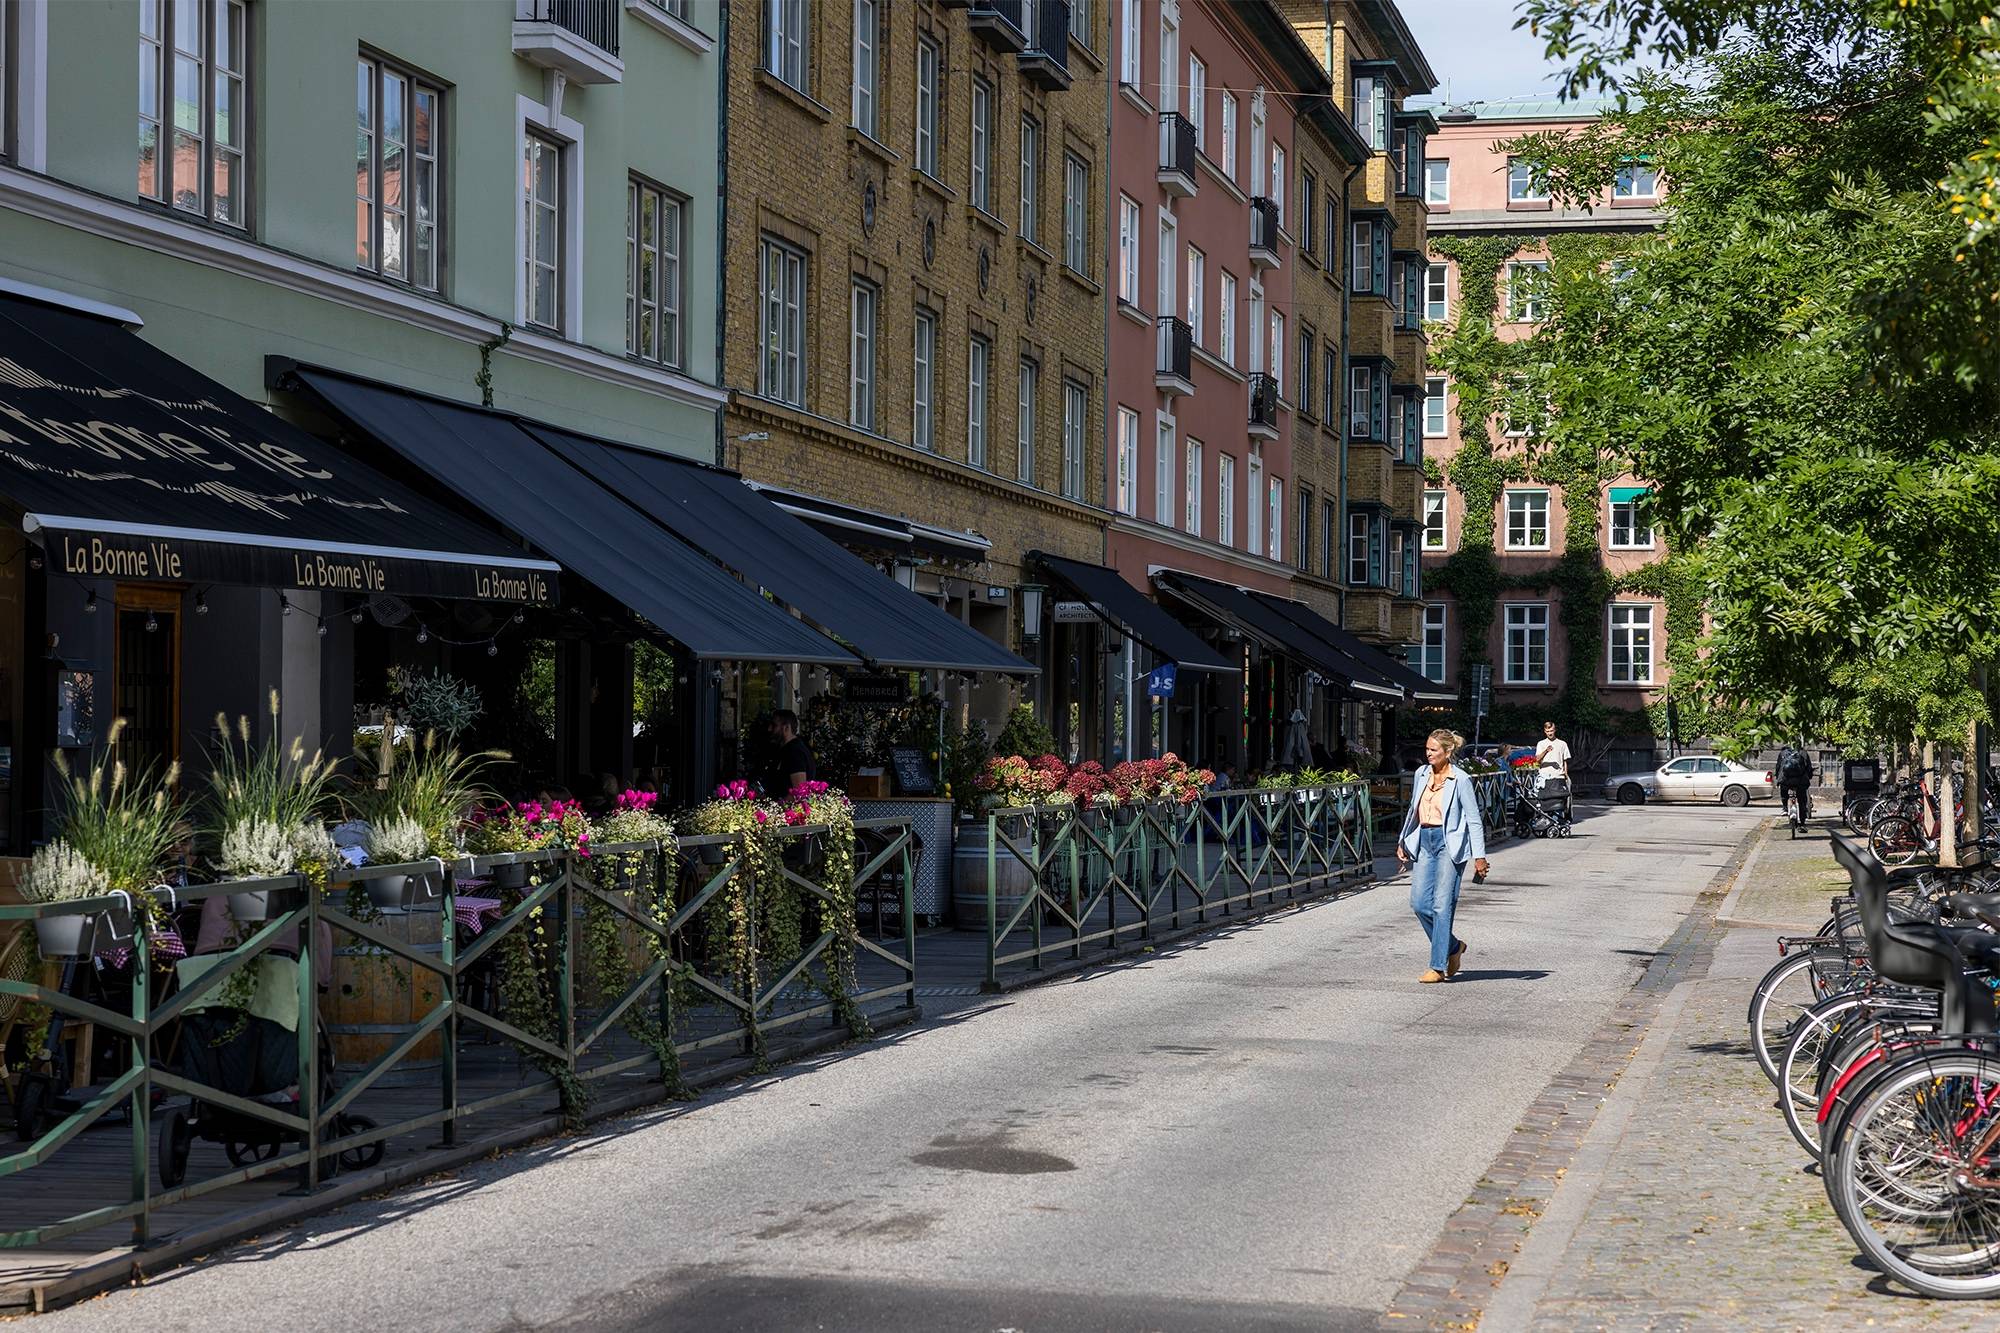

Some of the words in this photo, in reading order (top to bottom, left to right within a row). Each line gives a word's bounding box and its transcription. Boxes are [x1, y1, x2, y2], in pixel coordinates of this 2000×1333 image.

[64, 536, 87, 574] La
[92, 538, 149, 577] Bonne
[151, 542, 182, 578] Vie
[295, 554, 315, 586] La
[316, 555, 362, 589] Bonne
[361, 559, 385, 591] Vie
[475, 569, 490, 598] La
[492, 570, 527, 600] Bonne
[528, 573, 547, 601] Vie
